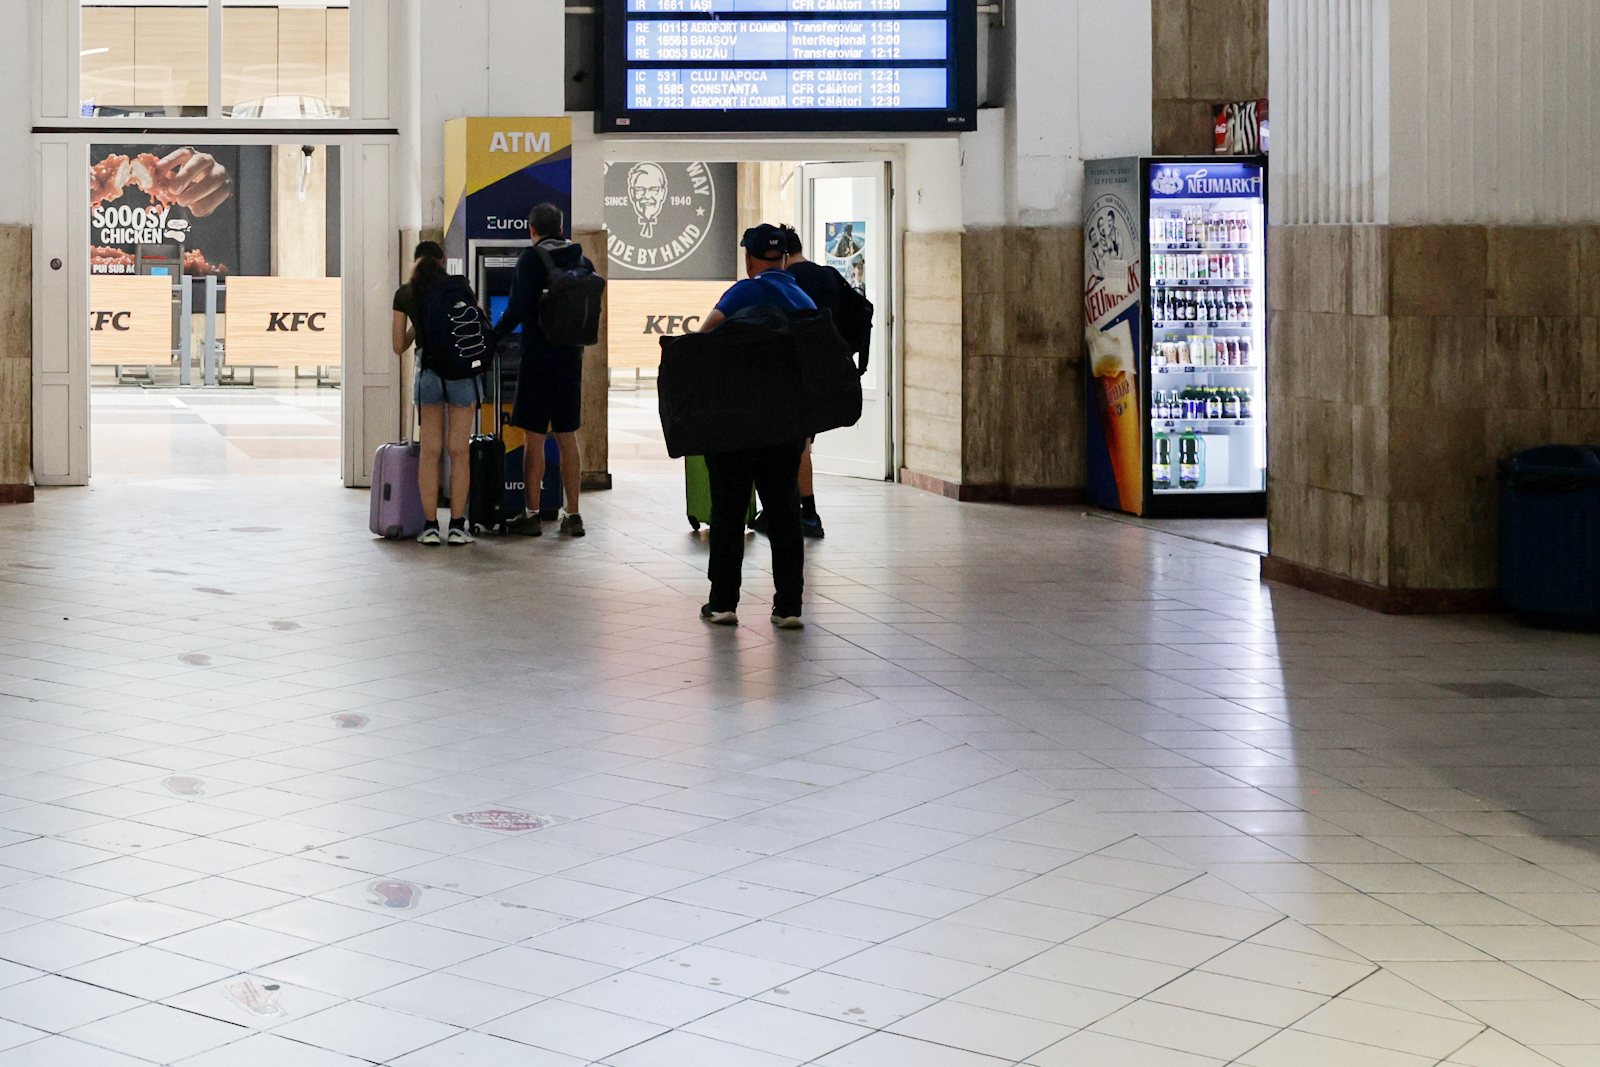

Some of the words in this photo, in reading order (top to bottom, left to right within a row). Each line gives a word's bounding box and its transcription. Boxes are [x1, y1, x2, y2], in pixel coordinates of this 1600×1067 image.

[636, 0, 646, 10] IR
[657, 0, 683, 10] 1661
[691, 0, 712, 11] IAȘI
[793, 0, 814, 10] CFR
[818, 0, 862, 10] Călători
[871, 0, 900, 10] 11:50
[636, 23, 649, 32] RE
[657, 23, 688, 32] 10113
[691, 23, 738, 32] AEROPORT
[741, 23, 747, 32] H
[750, 21, 787, 32] COANDĂ
[793, 22, 863, 32] Transferoviar
[871, 22, 900, 32] 11:50
[636, 36, 646, 46] IR
[657, 36, 688, 46] 16569
[691, 36, 737, 47] BRAȘOV
[792, 35, 866, 46] InterRegional
[871, 35, 900, 45] 12:00
[636, 49, 649, 59] RE
[657, 49, 688, 59] 10053
[691, 47, 727, 59] BUZĂU
[793, 48, 863, 58] Transferoviar
[871, 48, 900, 58] 12:12
[636, 71, 646, 81] IC
[657, 71, 677, 81] 531
[691, 71, 718, 81] CLUJ
[721, 71, 767, 81] NAPOCA
[793, 71, 814, 80] CFR
[818, 71, 862, 80] Călători
[871, 71, 900, 80] 12:21
[636, 84, 646, 94] IR
[657, 84, 684, 94] 1585
[690, 84, 759, 96] CONSTANȚA
[793, 83, 814, 93] CFR
[818, 83, 862, 93] Călători
[871, 83, 900, 93] 12:30
[636, 97, 652, 107] RM
[657, 97, 684, 107] 7923
[691, 97, 738, 107] AEROPORT
[741, 97, 747, 107] H
[750, 96, 787, 107] COANDĂ
[793, 96, 814, 106] CFR
[818, 96, 862, 106] Călători
[871, 96, 900, 106] 12:30
[489, 132, 550, 153] ATM
[686, 162, 710, 196] WAY
[1186, 168, 1256, 194] NEUMARKT
[604, 196, 628, 206] SINCE
[670, 196, 692, 206] 1940
[92, 204, 171, 230] SOOOSY
[101, 228, 162, 244] CHICKEN
[637, 248, 657, 264] BY
[660, 224, 701, 262] HAND
[93, 264, 107, 273] PUI
[108, 264, 124, 273] SUB
[90, 312, 130, 330] FC
[266, 312, 326, 331] KFC
[643, 316, 700, 334] KFC
